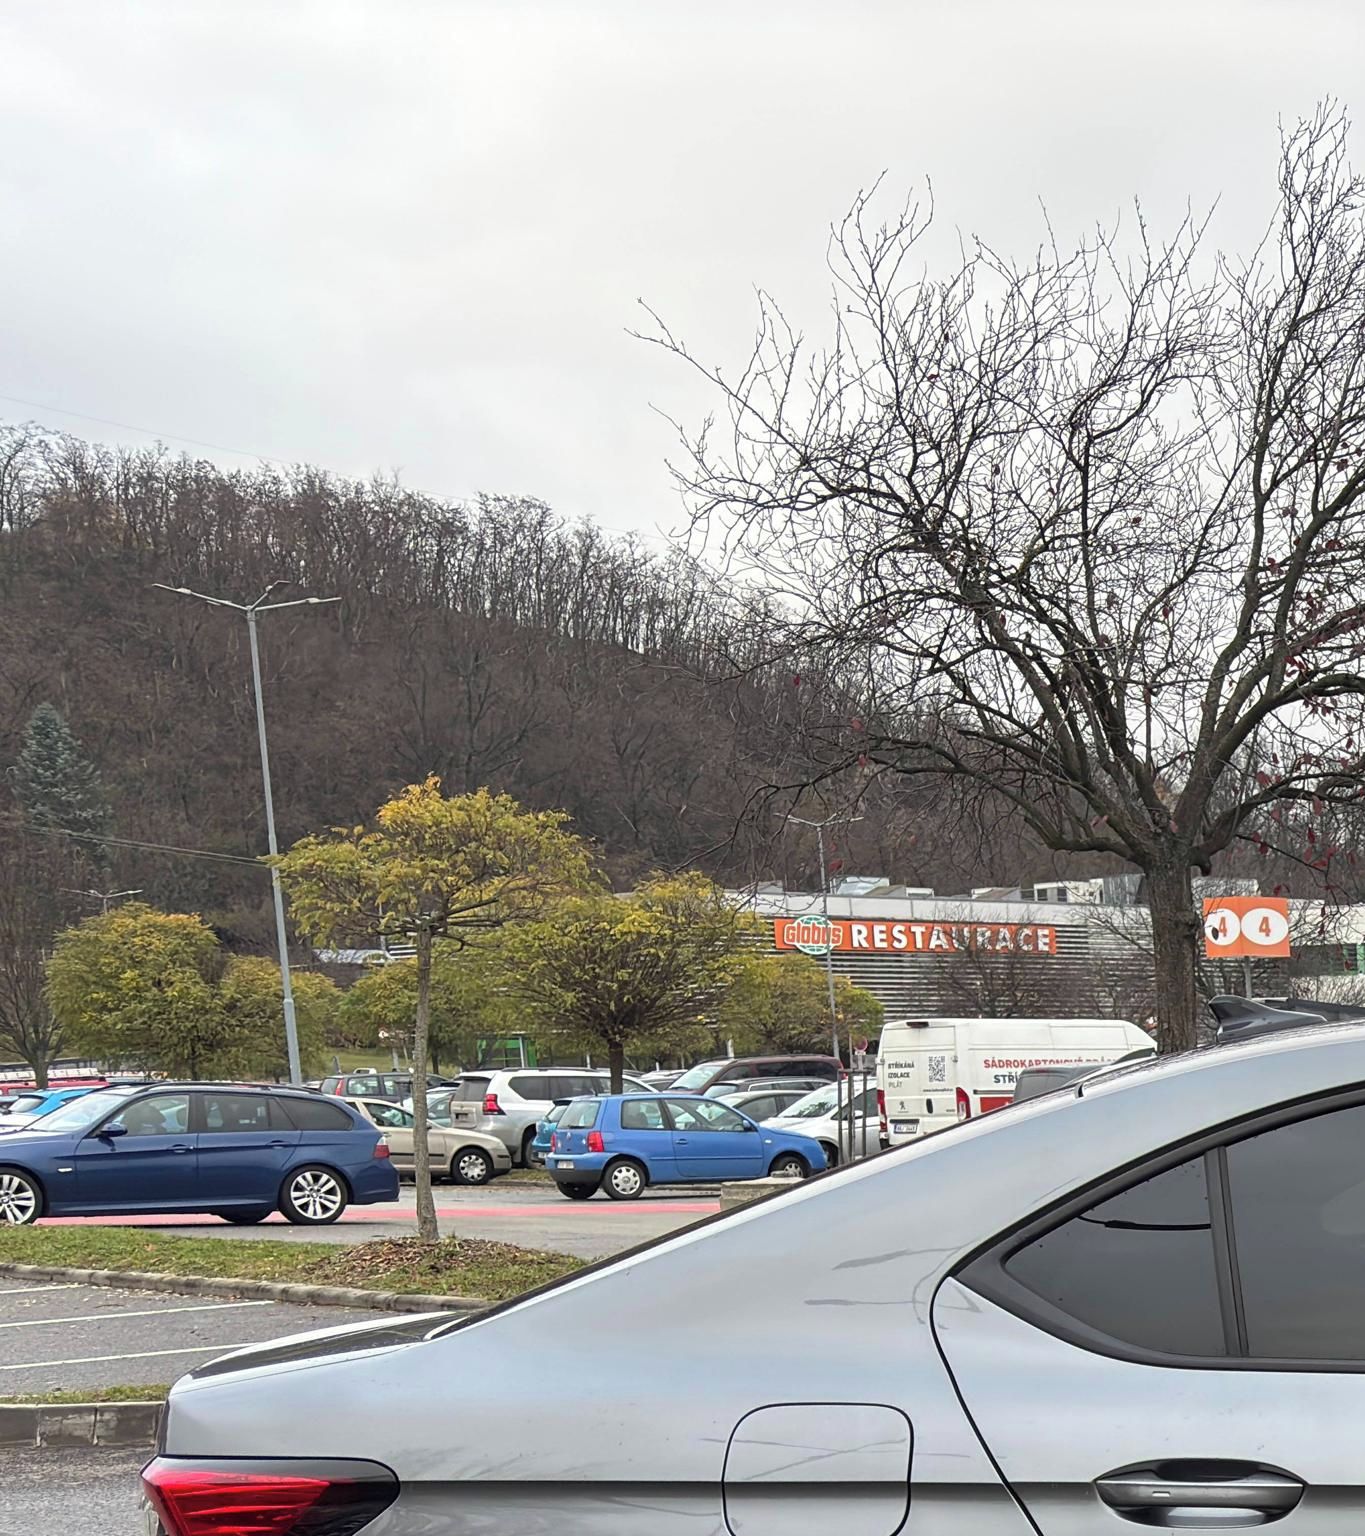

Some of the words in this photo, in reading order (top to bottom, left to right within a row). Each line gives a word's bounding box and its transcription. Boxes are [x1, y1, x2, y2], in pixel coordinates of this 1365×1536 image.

[785, 920, 842, 945] Globus
[851, 924, 1050, 951] RESTAURACE
[1219, 916, 1228, 938] 4
[1258, 916, 1271, 937] 4
